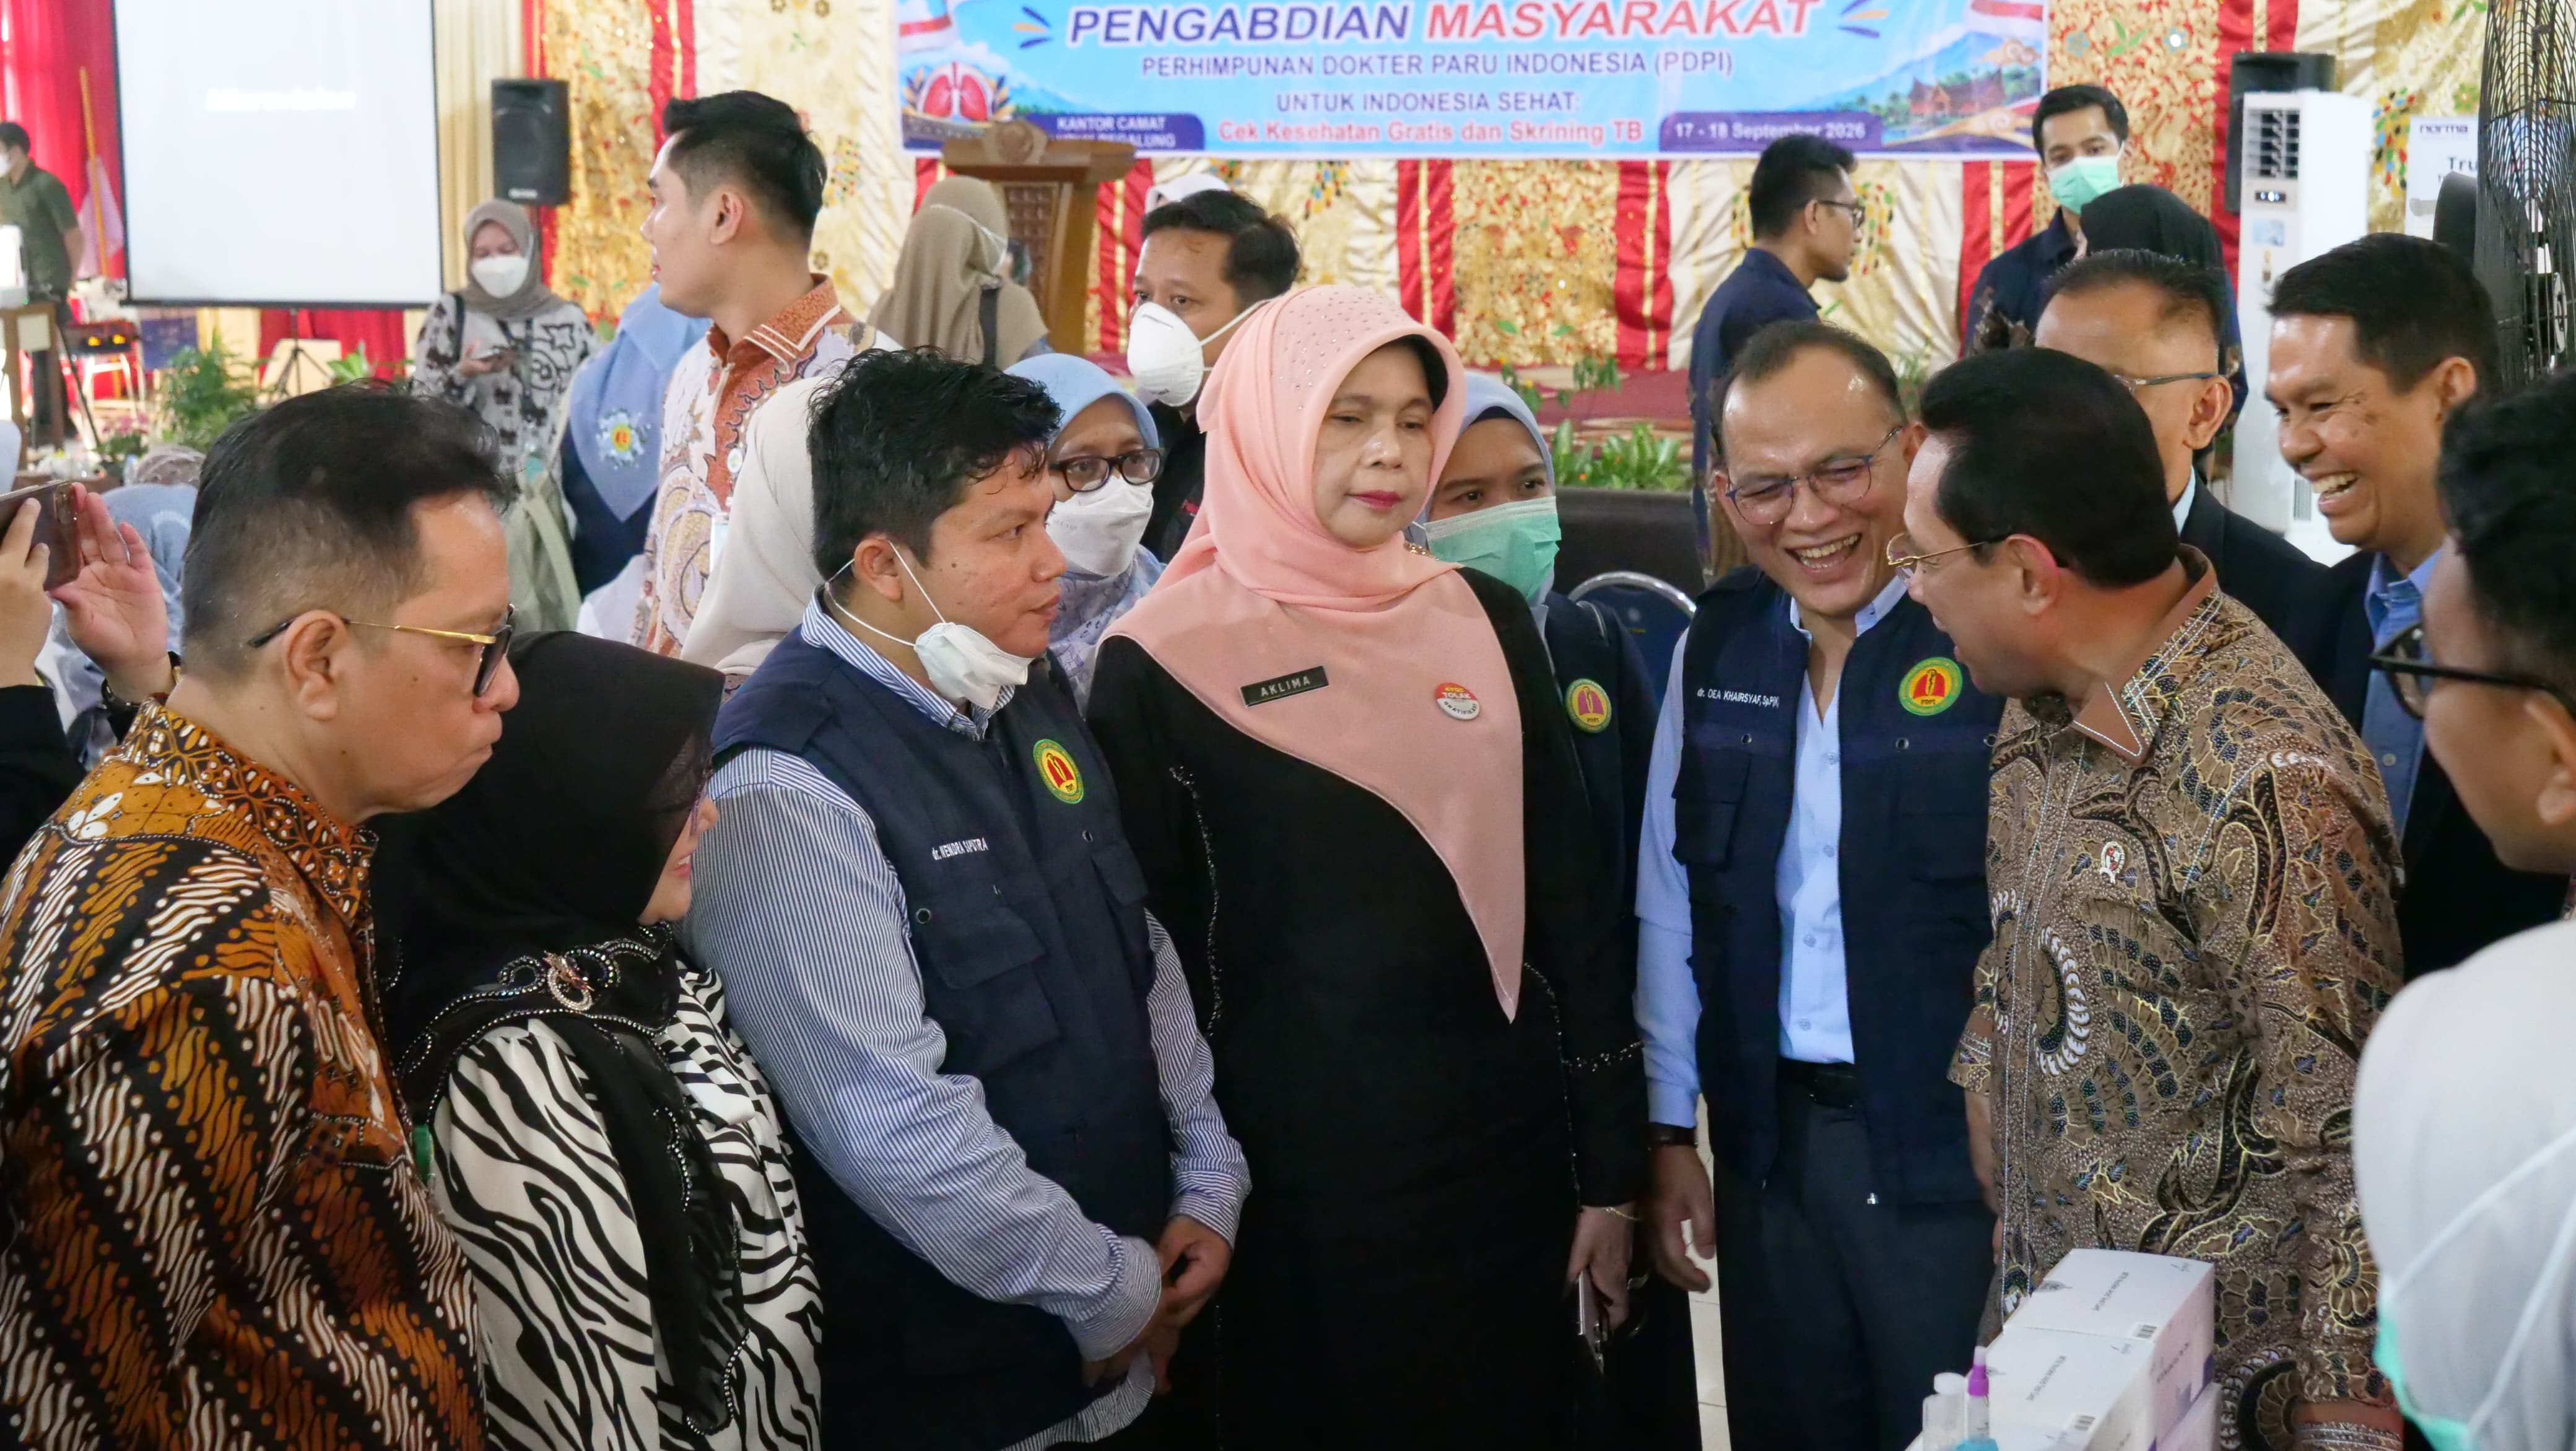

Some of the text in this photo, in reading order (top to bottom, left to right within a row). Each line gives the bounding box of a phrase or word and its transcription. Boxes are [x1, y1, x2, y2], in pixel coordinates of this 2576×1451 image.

[1070, 0, 1821, 43] PENGABDIAN MASYARAKAT
[1142, 50, 1733, 77] PERHIMPUNAN DOKTER PARU INDONESIA (PDPI)
[1276, 92, 1578, 112] UNTUK INDONESIA SEHAT:
[1056, 116, 1166, 131] KANTOR CAMAT
[1218, 120, 1642, 146] Cek Kesehatan Gratis dan Skrining TB
[1676, 123, 1694, 138] 17
[1260, 676, 1312, 697] AKLIMA
